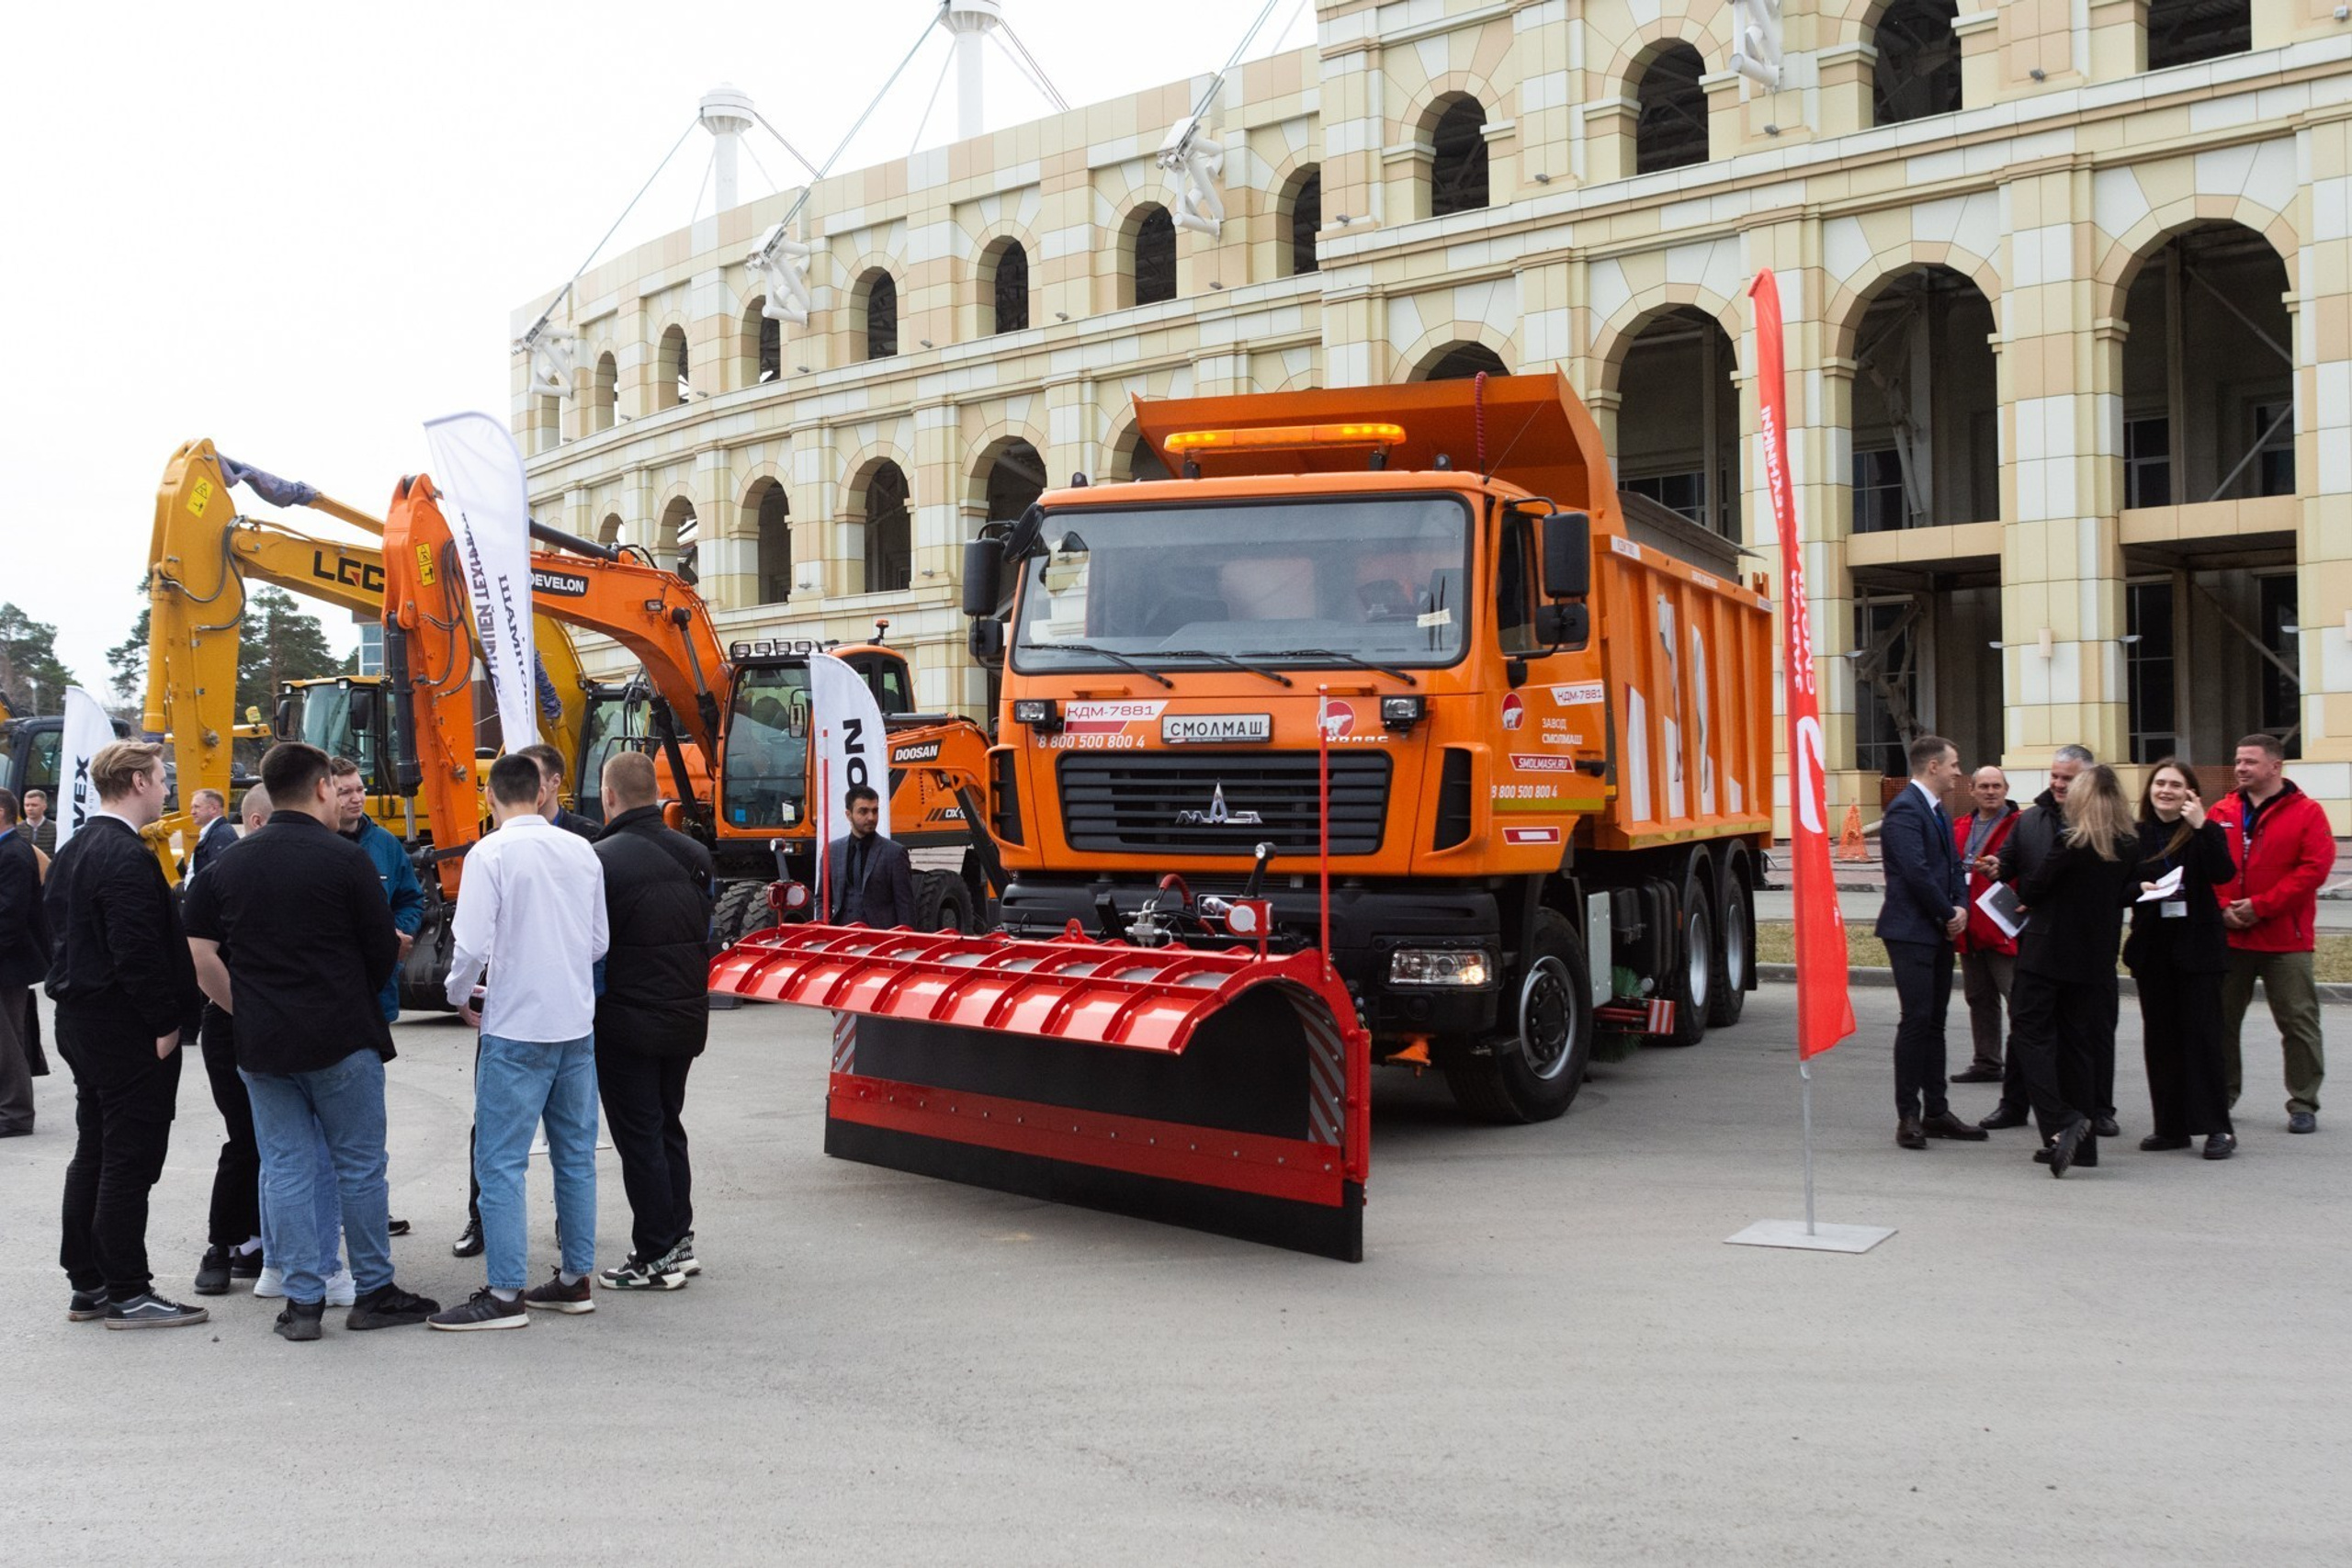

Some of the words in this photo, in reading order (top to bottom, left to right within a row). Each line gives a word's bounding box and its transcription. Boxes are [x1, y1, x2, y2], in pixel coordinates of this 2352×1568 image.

[1557, 689, 1603, 702] КДМ-7881
[1067, 705, 1155, 719] КДМ-7881
[1170, 721, 1262, 736] СМОЛМАШ
[1542, 718, 1566, 730] ЗАВОД
[1038, 736, 1046, 748] 8
[1050, 735, 1075, 748] 800
[1079, 735, 1103, 748] 500
[1107, 735, 1133, 748] 800
[1136, 735, 1145, 748] 4
[1542, 733, 1583, 745] СМОЛМАШ
[895, 745, 939, 761] DOOSAN
[1518, 758, 1567, 770] SMOLMASH.RU
[1498, 785, 1516, 798] 800
[1517, 785, 1533, 798] 500
[1535, 785, 1551, 798] 800
